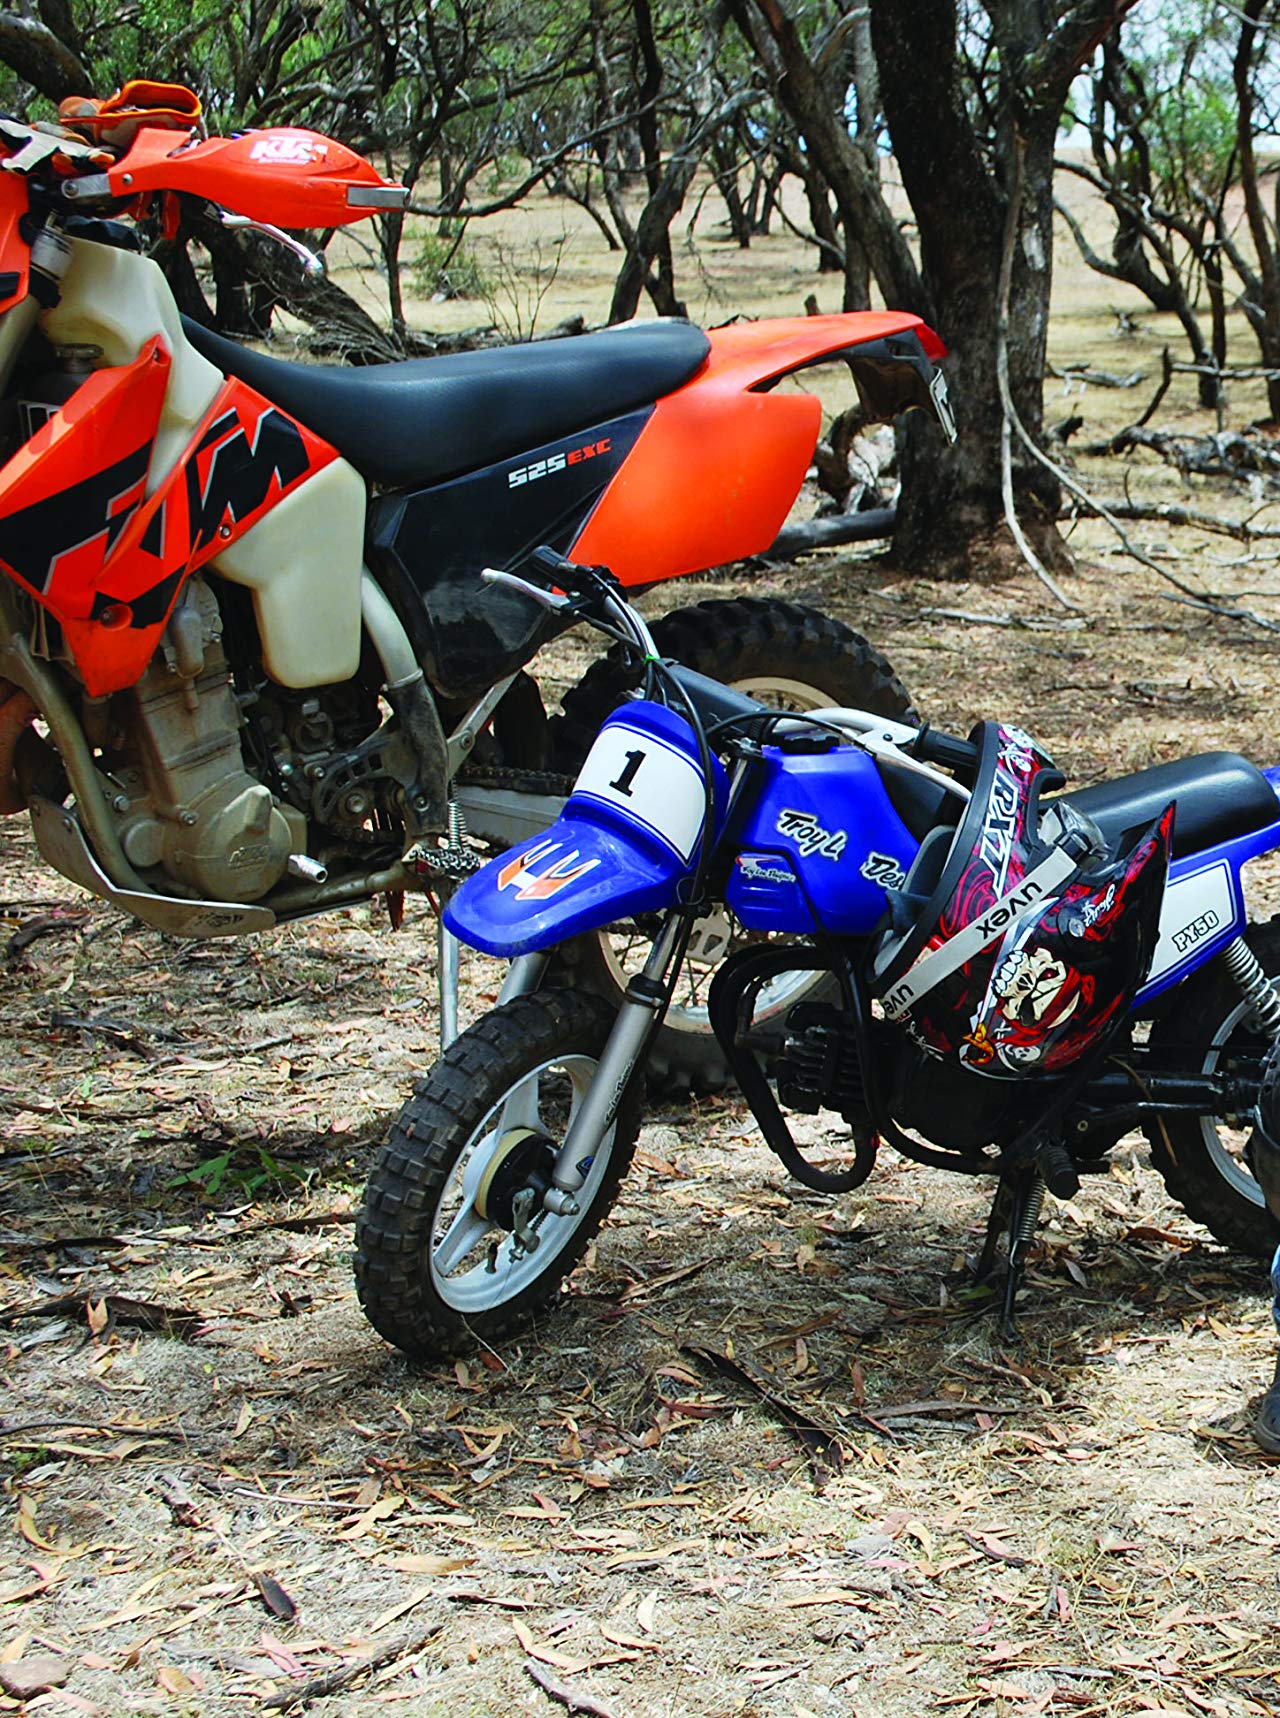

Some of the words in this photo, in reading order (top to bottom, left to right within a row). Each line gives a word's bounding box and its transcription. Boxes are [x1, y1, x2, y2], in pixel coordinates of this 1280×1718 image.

[508, 452, 566, 489] 525
[567, 438, 612, 466] EXC
[609, 750, 646, 798] 1
[976, 882, 1043, 940] uvex
[1172, 910, 1219, 952] PY50
